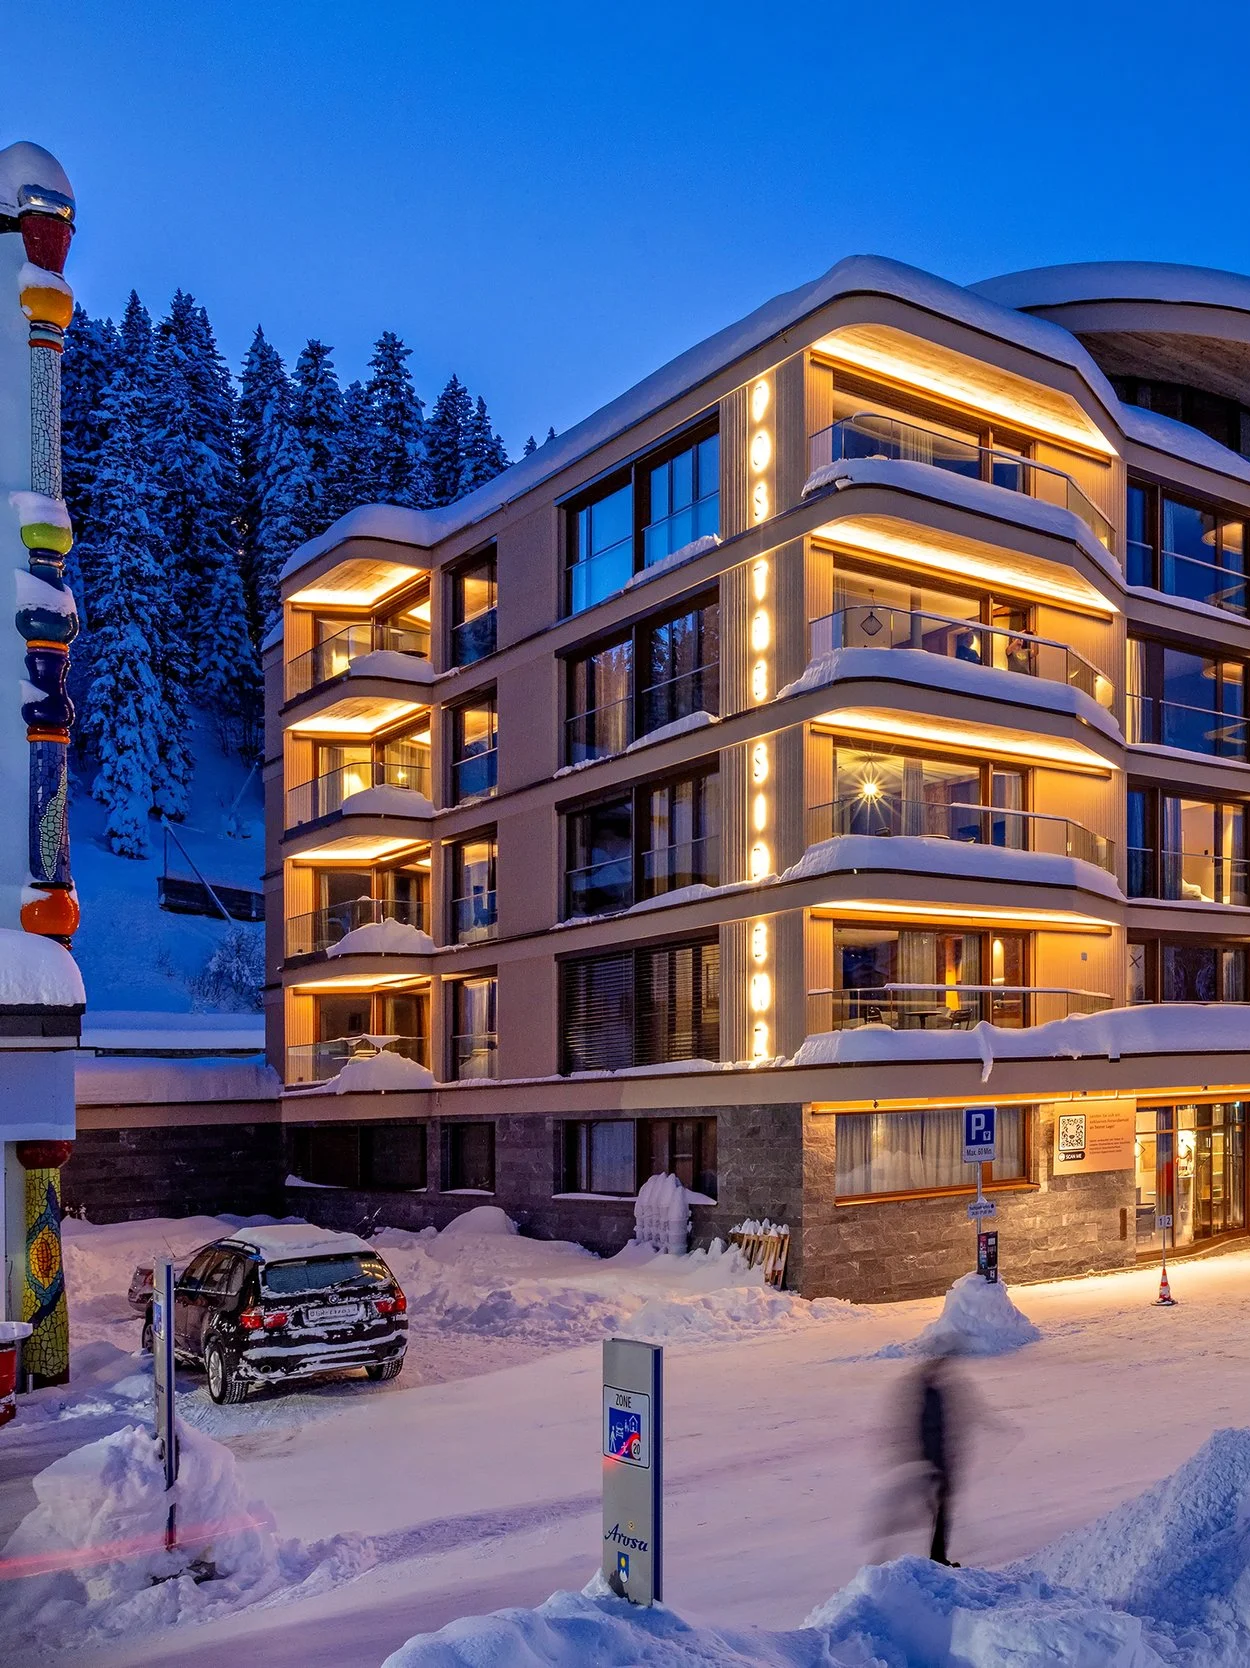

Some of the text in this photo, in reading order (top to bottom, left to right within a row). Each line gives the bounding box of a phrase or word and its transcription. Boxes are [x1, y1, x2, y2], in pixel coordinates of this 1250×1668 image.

[971, 1113, 985, 1140] P
[615, 1393, 632, 1408] ZONE
[633, 1443, 641, 1455] 20
[604, 1523, 648, 1552] Arosa
